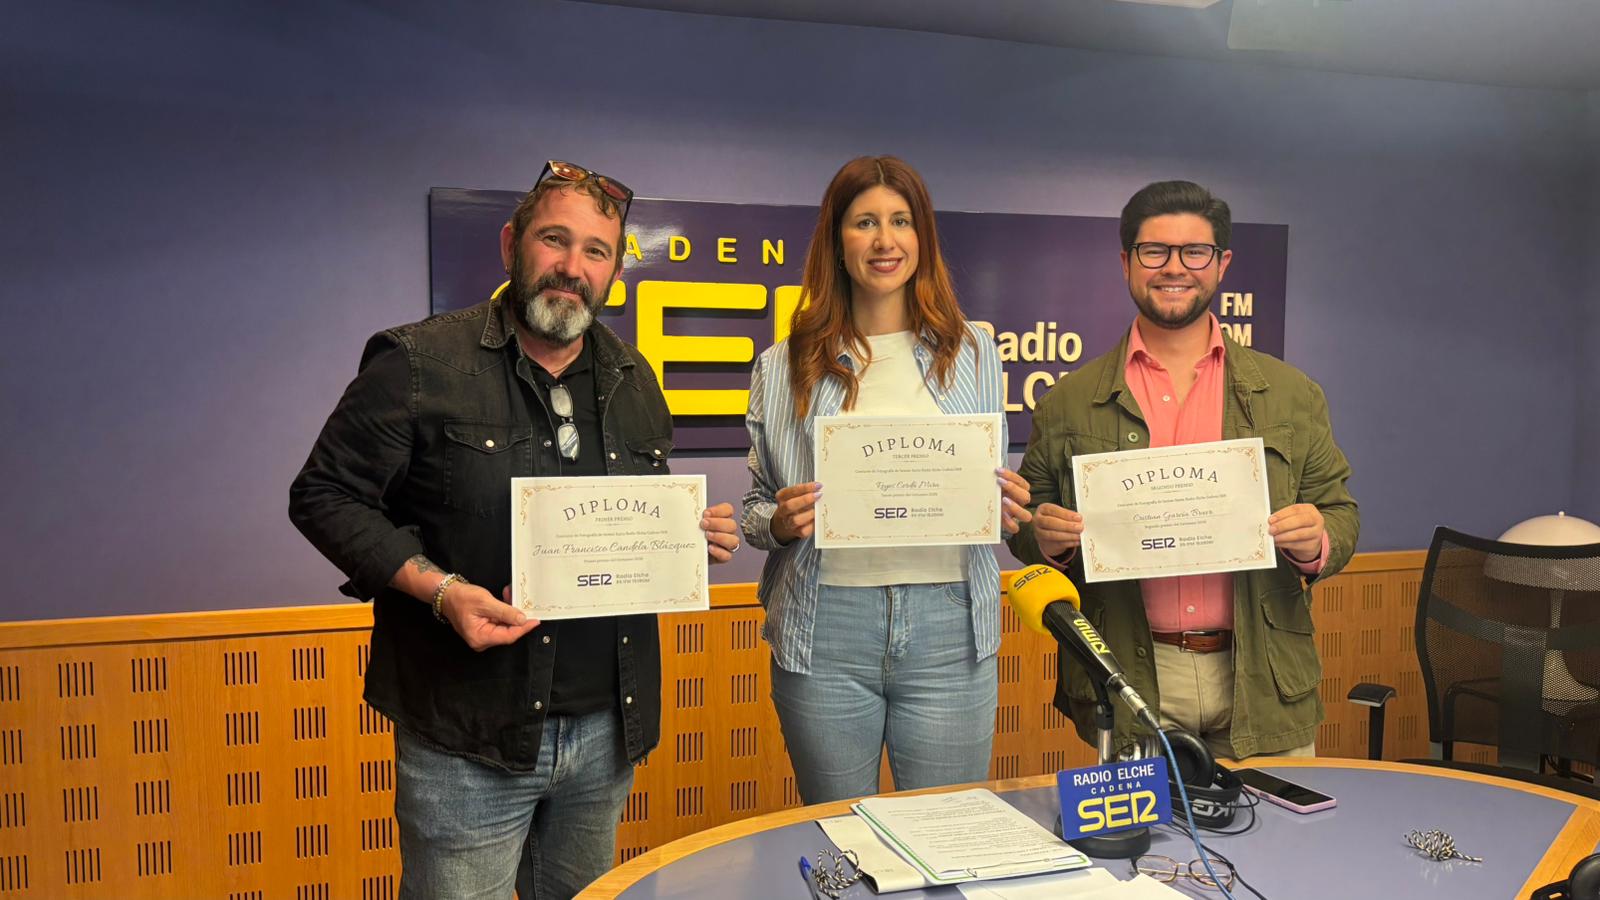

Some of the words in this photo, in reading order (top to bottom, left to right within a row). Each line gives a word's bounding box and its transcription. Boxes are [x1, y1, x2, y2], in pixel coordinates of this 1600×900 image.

[626, 233, 784, 264] ADEN
[1220, 293, 1253, 316] FM
[862, 436, 957, 458] DIPLOMA
[1121, 466, 1219, 491] DIPLOMA
[563, 498, 662, 521] DIPLOMA
[874, 507, 908, 519] SER
[532, 544, 560, 557] Juan
[562, 543, 608, 554] Francisco
[1141, 537, 1176, 550] SER
[577, 573, 612, 587] SER
[1013, 566, 1052, 591] SER
[1074, 618, 1111, 655] SER
[1073, 769, 1112, 786] RADIO
[1117, 763, 1155, 780] ELCHE
[1090, 781, 1142, 795] CADENA
[1077, 790, 1159, 832] SER
